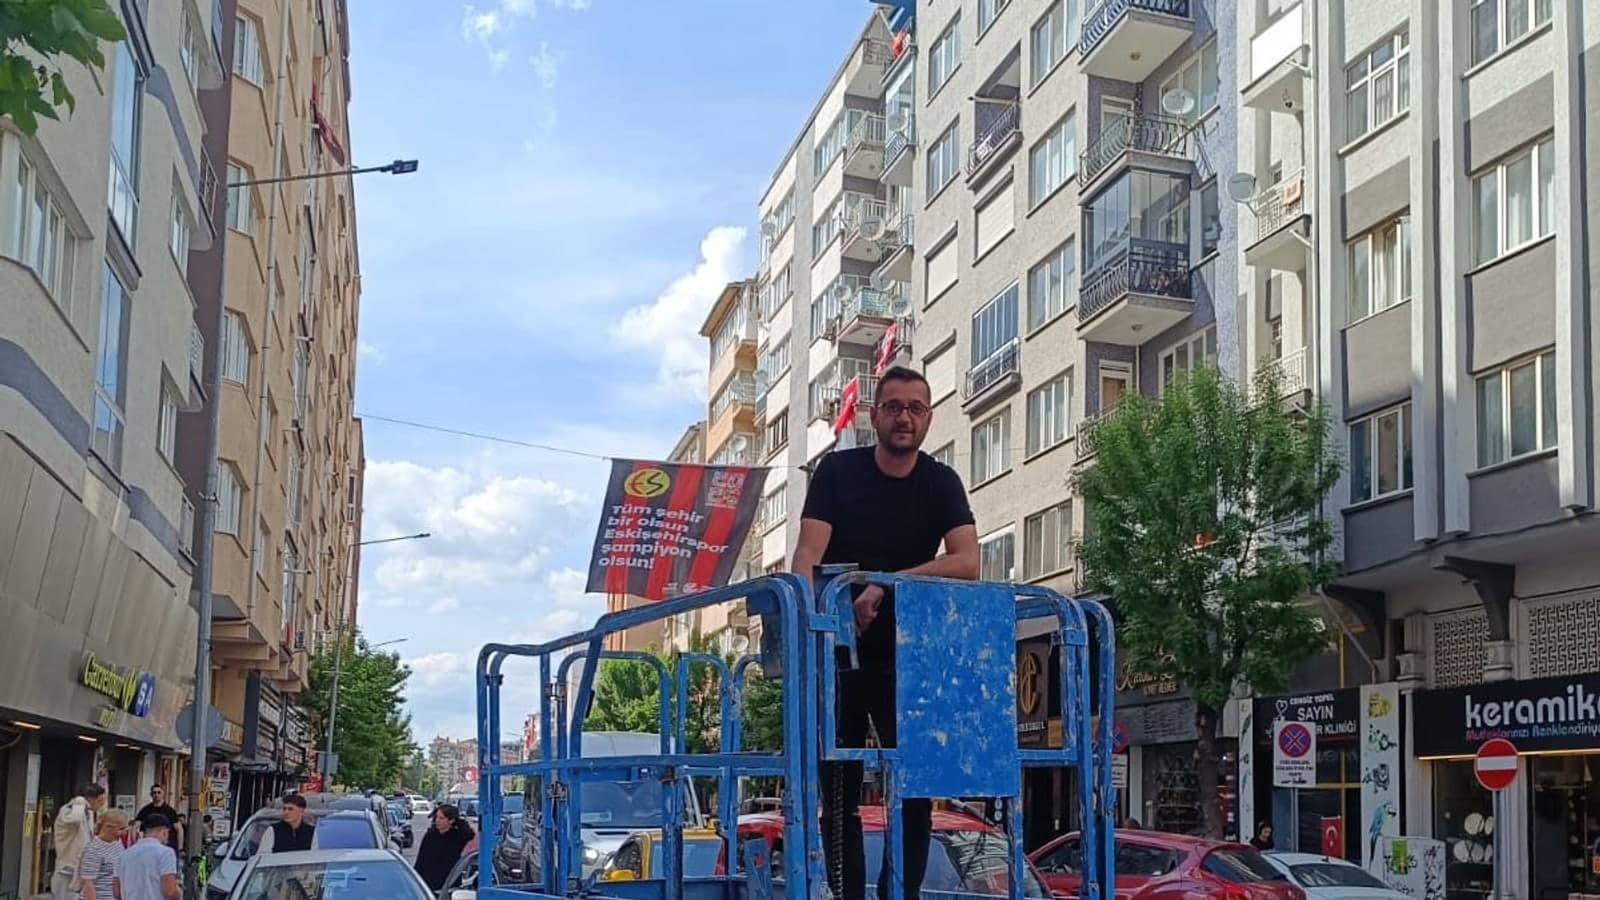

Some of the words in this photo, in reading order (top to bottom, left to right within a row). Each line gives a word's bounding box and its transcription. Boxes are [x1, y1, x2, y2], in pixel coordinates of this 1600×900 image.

[613, 504, 651, 515] Tüm
[656, 508, 704, 523] şehir
[607, 517, 633, 526] bir
[638, 517, 689, 532] olsun
[604, 530, 728, 552] Eskişehirspor
[600, 542, 692, 558] şampiyon
[599, 557, 655, 569] olsun!
[1297, 706, 1334, 721] SAYIN
[1465, 684, 1600, 728] keramik
